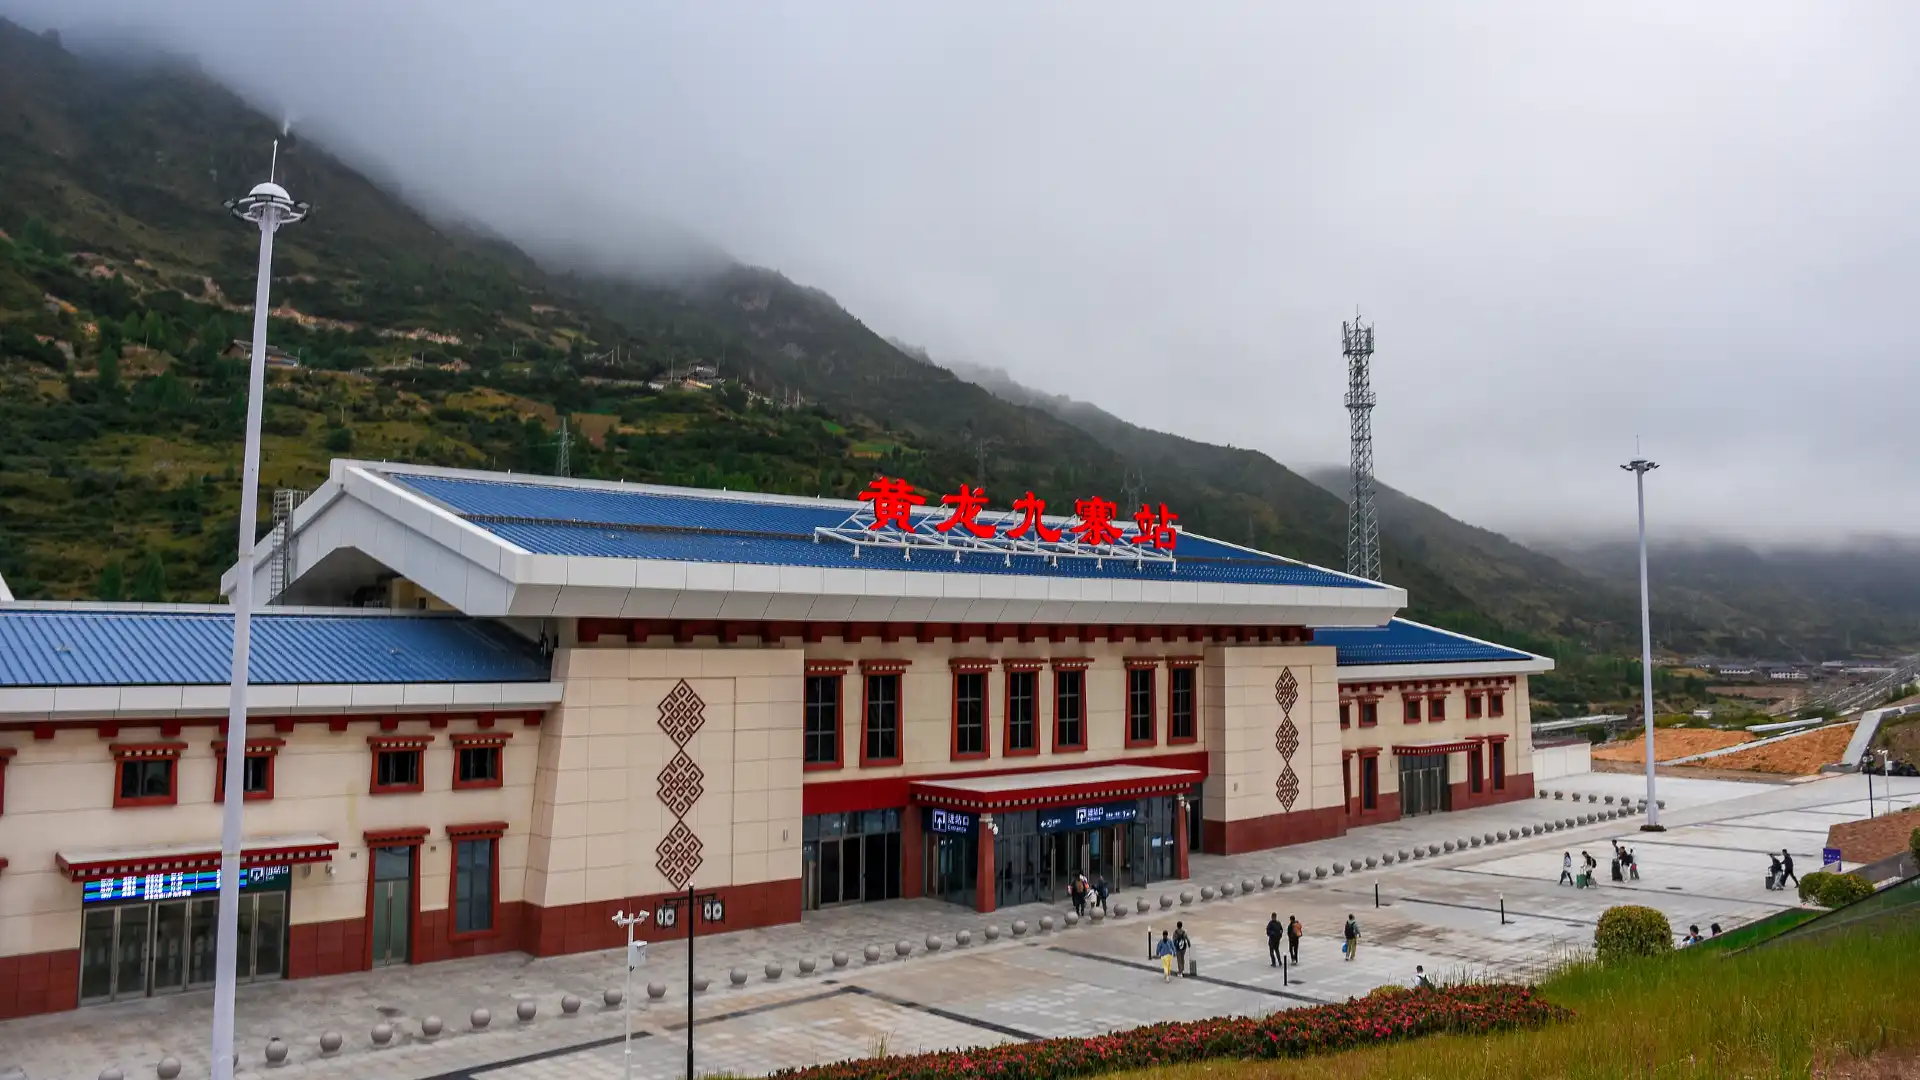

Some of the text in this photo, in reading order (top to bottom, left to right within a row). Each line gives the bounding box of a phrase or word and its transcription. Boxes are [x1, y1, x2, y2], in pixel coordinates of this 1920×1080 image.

[858, 476, 1178, 550] 黄龙九寨站
